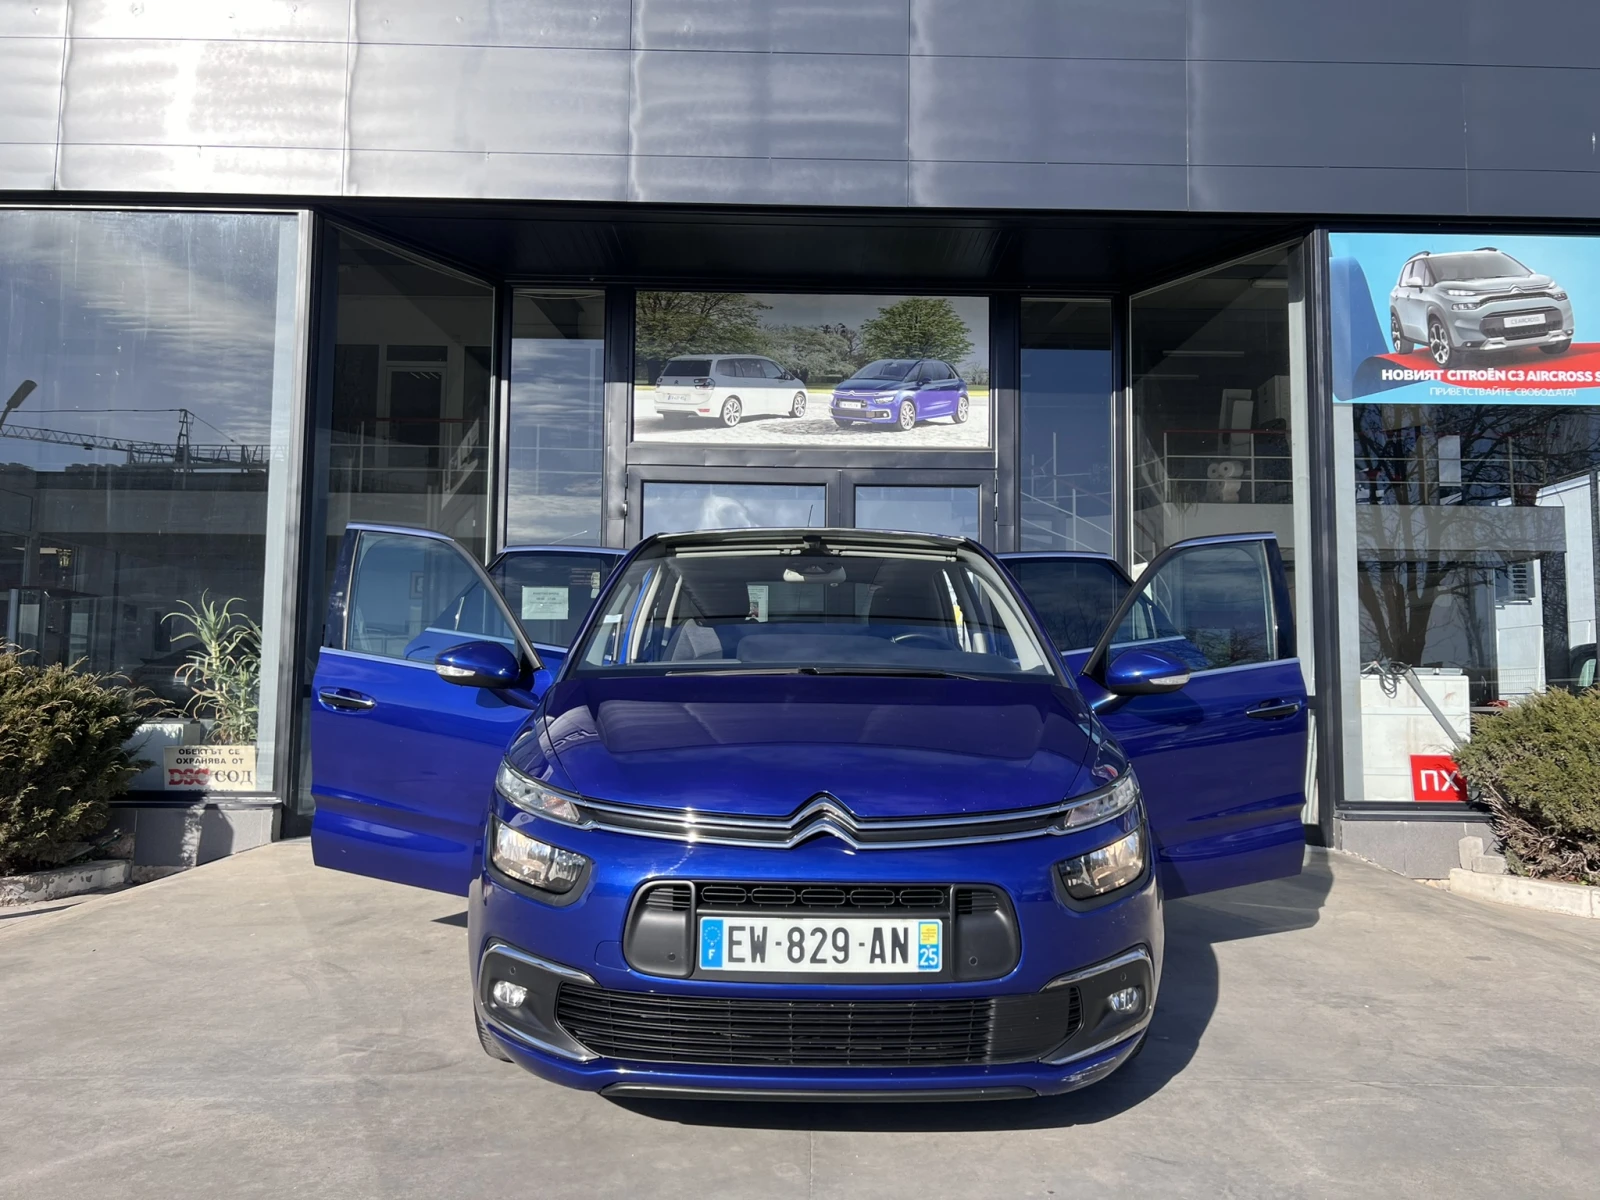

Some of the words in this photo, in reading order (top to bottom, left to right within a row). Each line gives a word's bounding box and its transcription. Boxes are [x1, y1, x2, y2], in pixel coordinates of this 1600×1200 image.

[1381, 369, 1443, 381] НОВИЯТ
[1447, 367, 1507, 382] CITROËN
[1508, 370, 1526, 382] C3
[1527, 370, 1593, 382] AIRCROSS
[1429, 386, 1511, 396] ПРИВЕТСТВАЙТЕ
[1514, 387, 1576, 397] СВОБОДАТА!
[214, 769, 253, 785] СОД
[1420, 769, 1460, 791] ПХ
[727, 925, 909, 964] EW-829-AN
[708, 948, 716, 960] F
[919, 947, 938, 966] 25
